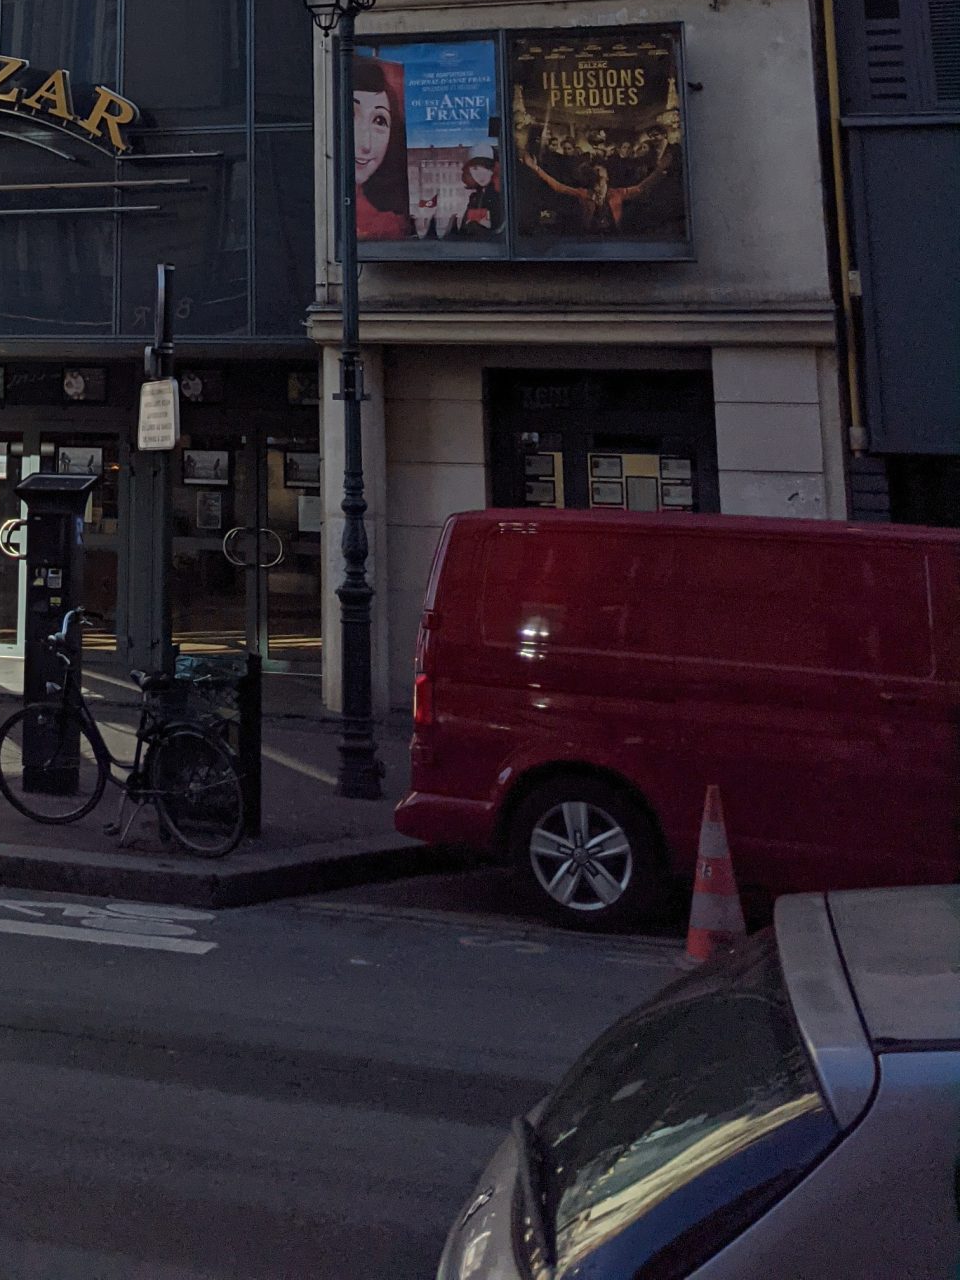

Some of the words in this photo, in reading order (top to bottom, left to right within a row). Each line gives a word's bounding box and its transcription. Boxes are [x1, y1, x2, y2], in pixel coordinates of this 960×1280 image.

[542, 68, 645, 90] ILLUSIONS
[550, 87, 639, 107] PERDUES
[424, 106, 481, 121] FRANK
